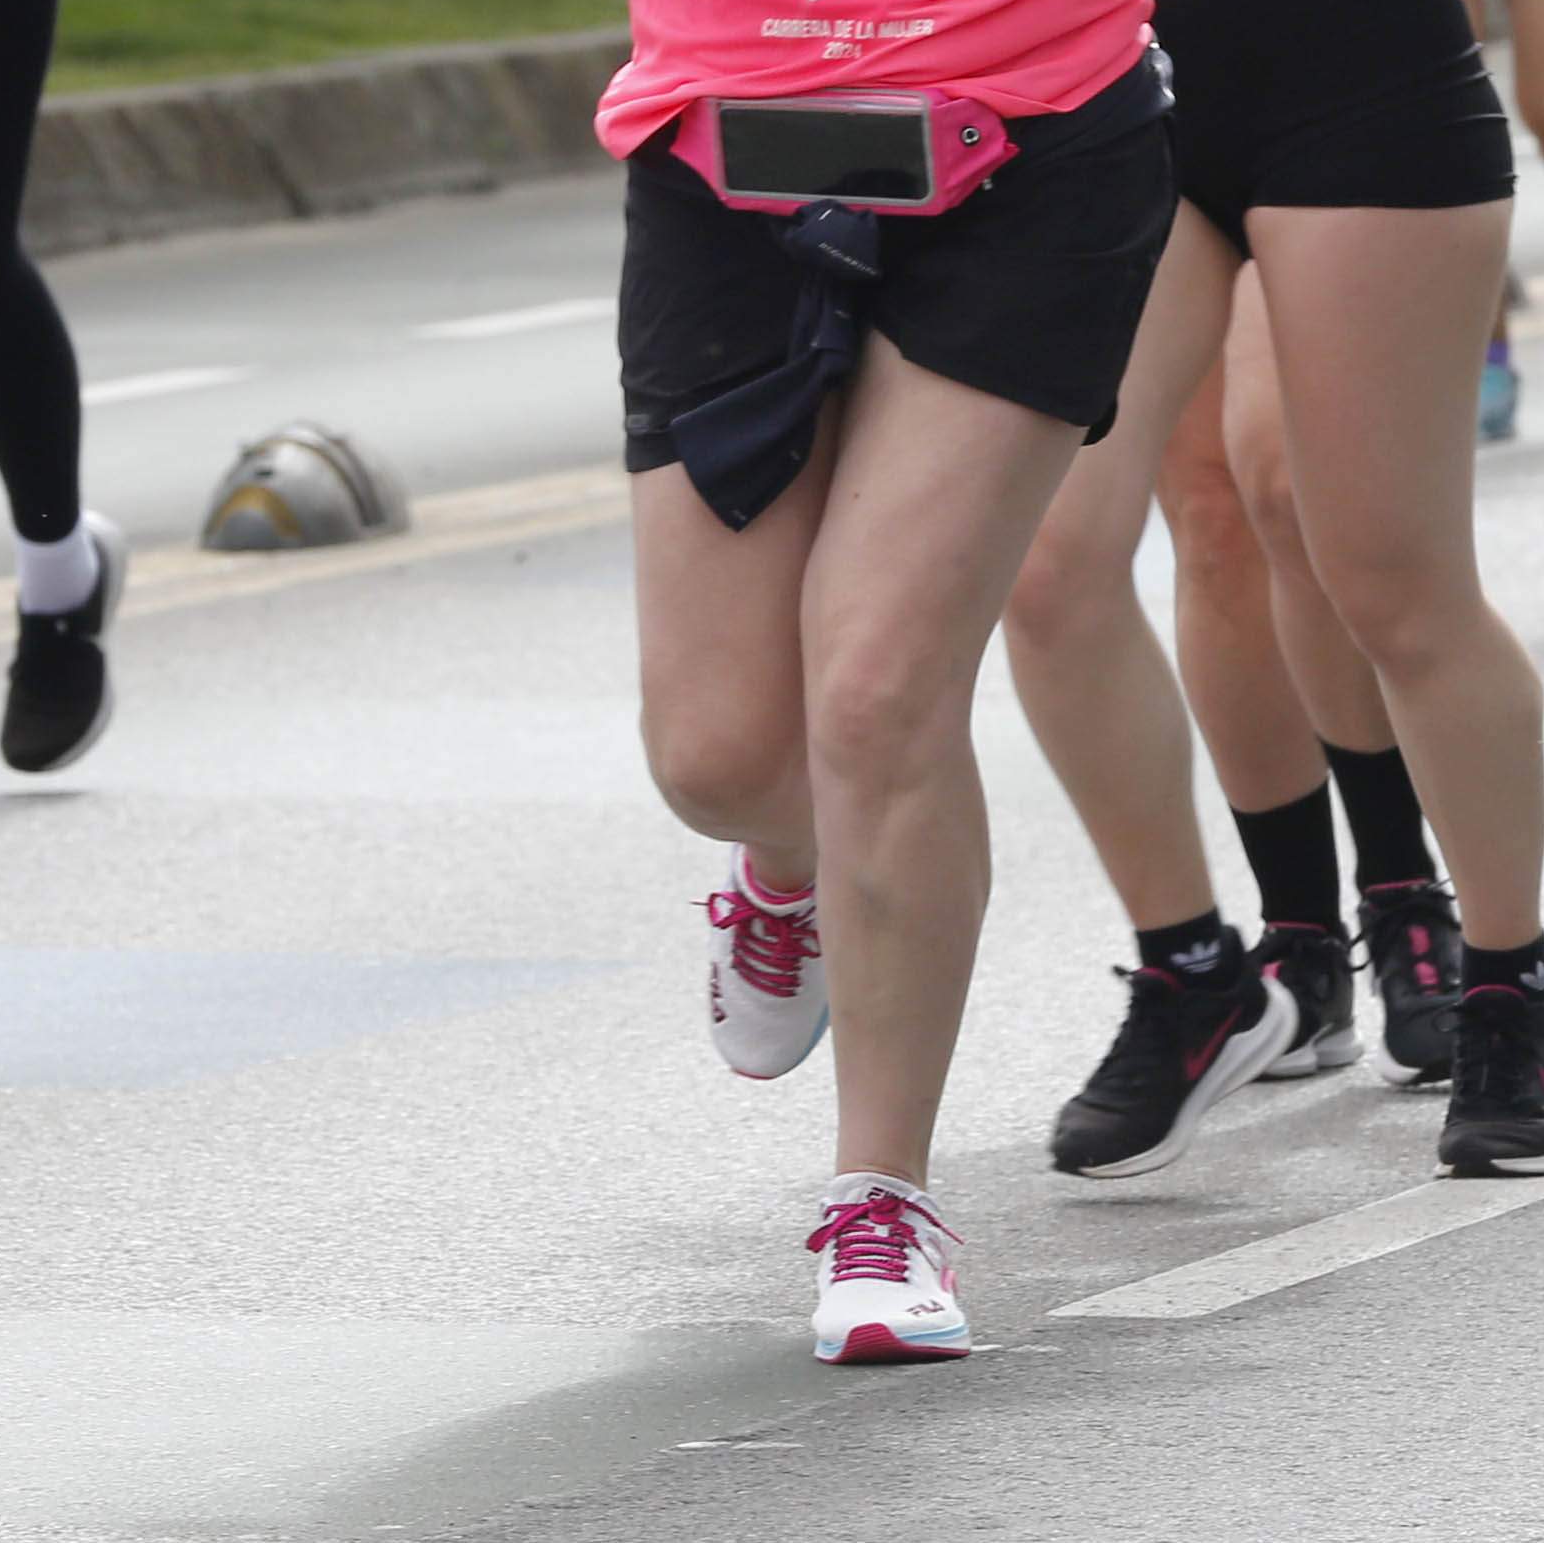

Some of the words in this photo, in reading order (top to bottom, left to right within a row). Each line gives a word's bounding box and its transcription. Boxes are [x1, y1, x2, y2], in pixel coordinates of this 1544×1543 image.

[760, 18, 832, 38] CARRERA
[833, 19, 855, 39] DE
[855, 20, 876, 40] LA
